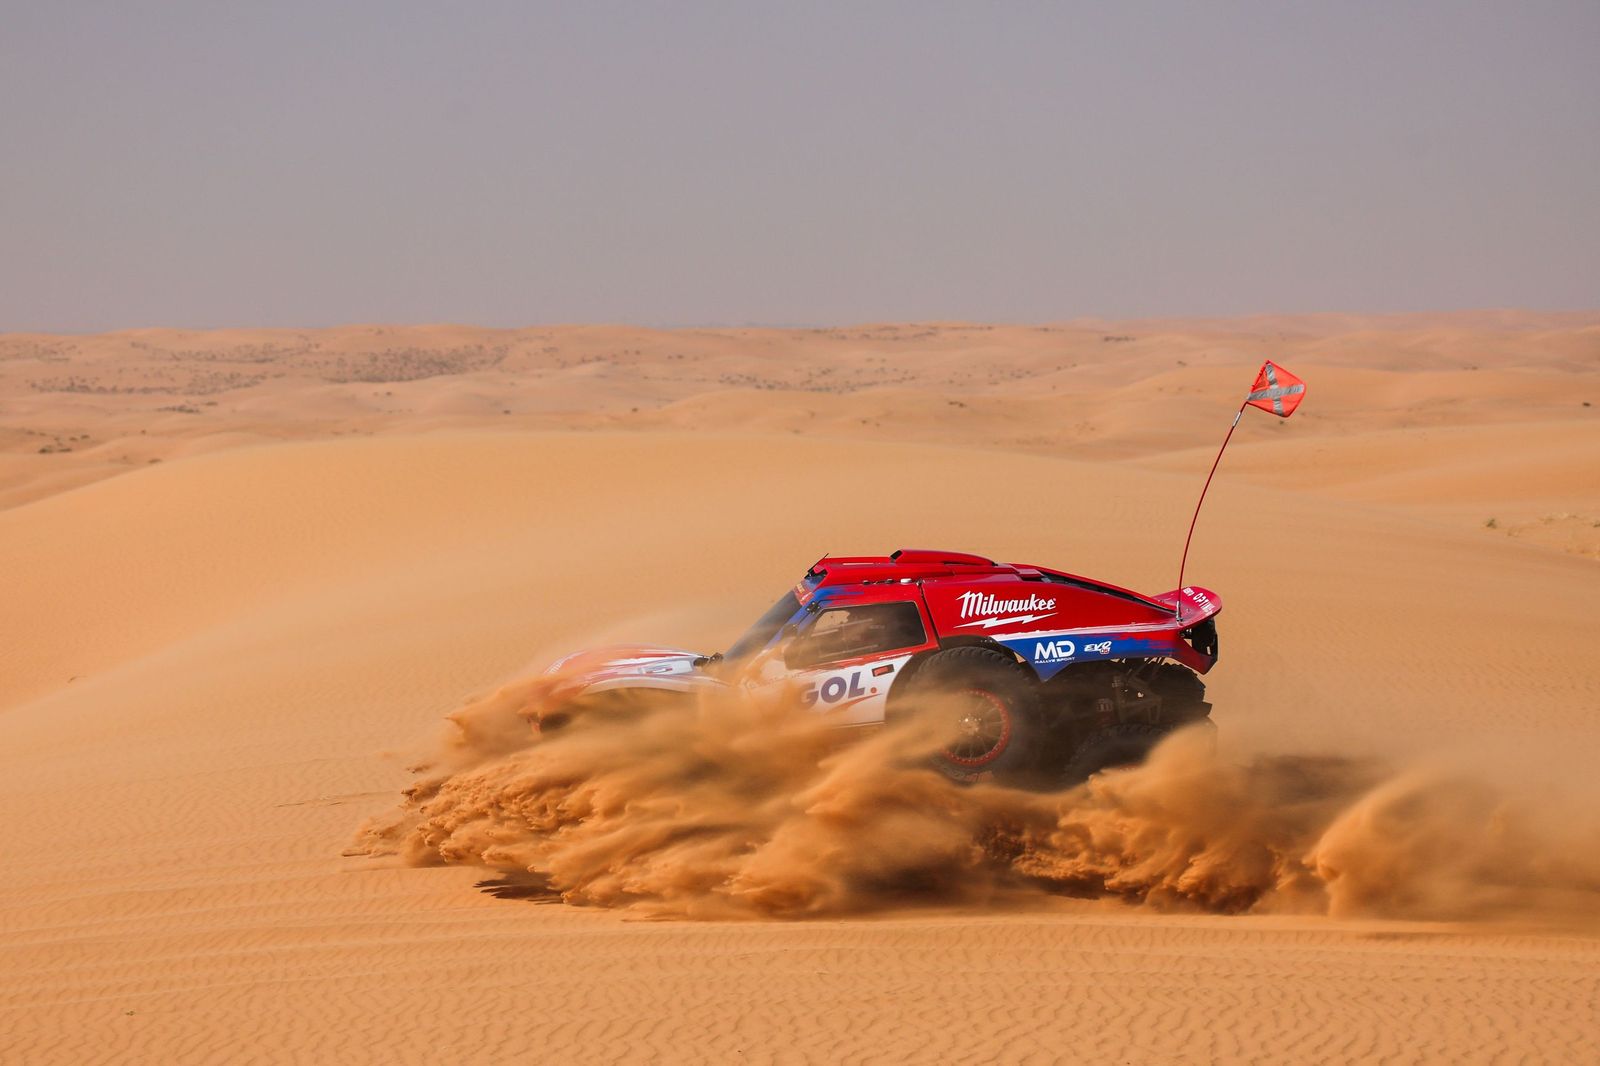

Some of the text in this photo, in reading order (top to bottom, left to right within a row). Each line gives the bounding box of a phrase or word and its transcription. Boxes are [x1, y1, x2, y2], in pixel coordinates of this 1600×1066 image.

[956, 591, 1056, 619] Milwaukee
[1035, 640, 1075, 660] MD
[1084, 640, 1112, 652] EVO
